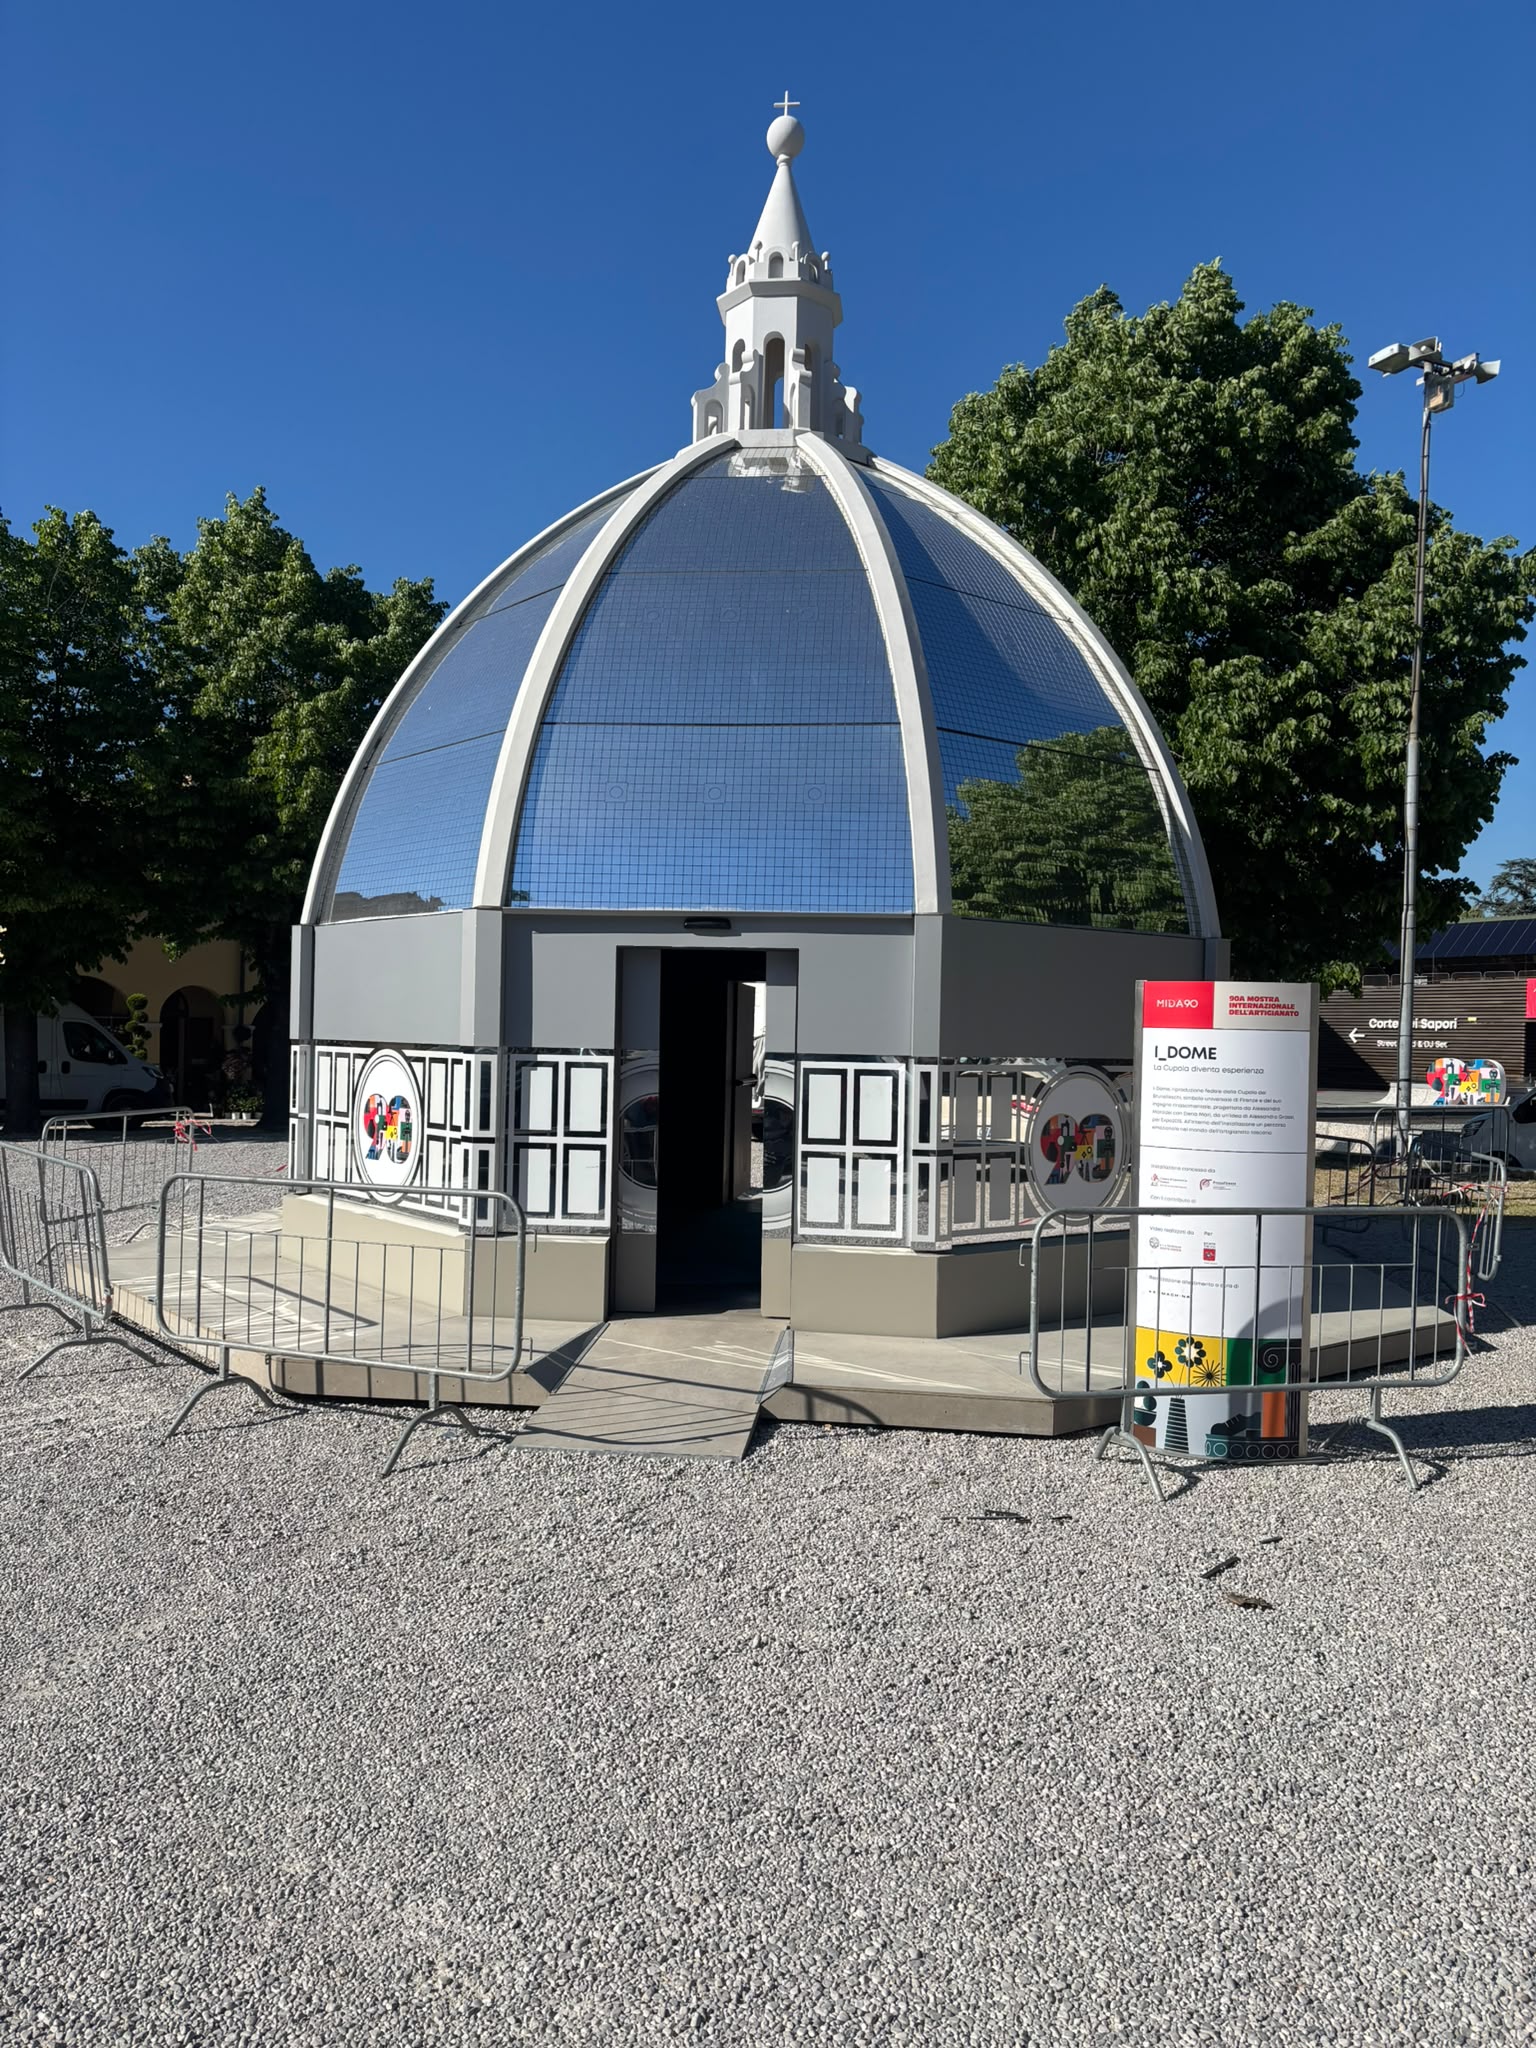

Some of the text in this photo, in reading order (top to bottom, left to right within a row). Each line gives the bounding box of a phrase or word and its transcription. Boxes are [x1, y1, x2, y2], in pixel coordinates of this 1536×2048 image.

[1157, 999, 1198, 1008] MIDA90
[1229, 1002, 1295, 1010] INTERNAZIONALE
[1229, 1009, 1299, 1017] DELL'ARTIGIANATO
[1369, 1018, 1399, 1029] Corte
[1421, 1018, 1457, 1032] Sapori
[1163, 1064, 1189, 1072] Cupola
[1191, 1065, 1220, 1073] diventa
[1222, 1067, 1264, 1075] esperienza
